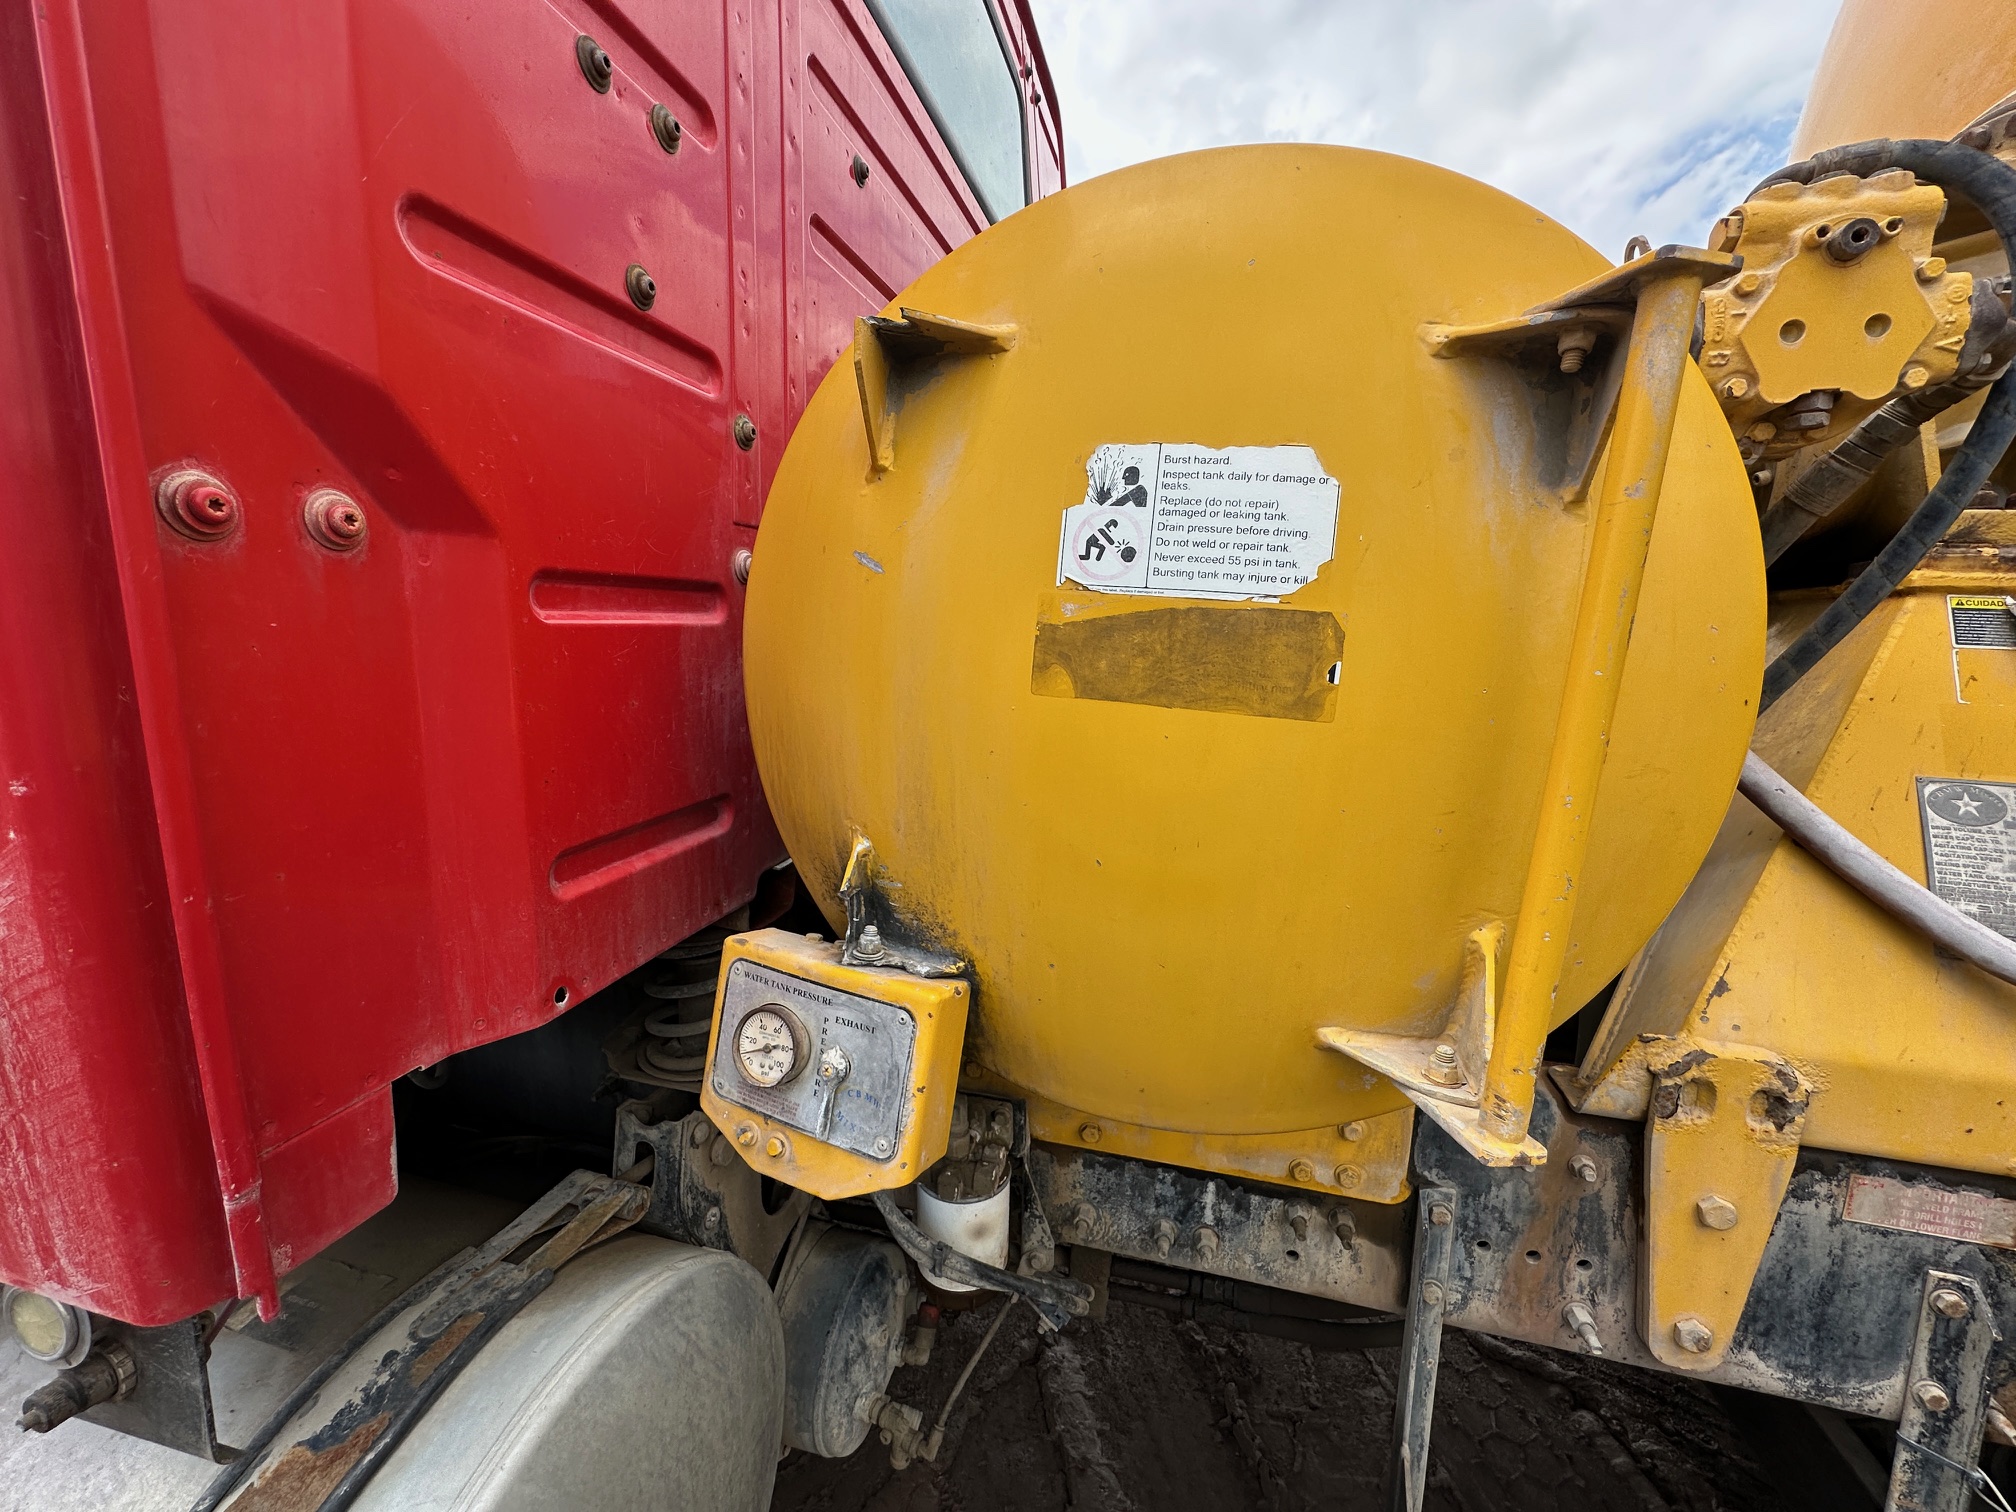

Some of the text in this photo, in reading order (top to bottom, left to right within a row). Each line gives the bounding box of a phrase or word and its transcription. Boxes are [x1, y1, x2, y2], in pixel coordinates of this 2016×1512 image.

[1164, 455, 1232, 465] Burst hazard.
[1161, 481, 1190, 490] leaks.
[1163, 470, 1199, 481] Inspect
[1203, 471, 1224, 479] tank
[1228, 471, 1252, 483] daily
[1256, 472, 1270, 481] for
[1272, 473, 1315, 486] damage
[1160, 496, 1279, 511] Replace (do not repair)
[1158, 507, 1206, 519] damaged
[1223, 510, 1260, 522] leaking
[1265, 512, 1289, 521] tank.
[1157, 522, 1310, 540] Drain pressure before driving.
[1156, 537, 1170, 546] Do
[1173, 539, 1189, 547] not
[1192, 539, 1216, 548] weld
[1233, 542, 1264, 552] repair
[1267, 543, 1291, 552] tank.
[1154, 553, 1300, 569] Never exceed 55 psi in tank.
[1153, 567, 1194, 580] Bursting
[1198, 570, 1219, 579] tank
[1223, 573, 1244, 583] may
[1248, 572, 1277, 584] injure
[744, 971, 833, 1006] WATER TANK PRESSURE
[835, 1016, 877, 1034] EXHAUST
[774, 1060, 784, 1068] 100
[814, 1017, 829, 1098] PRESURE
[1915, 1222, 1949, 1234] LOWER
